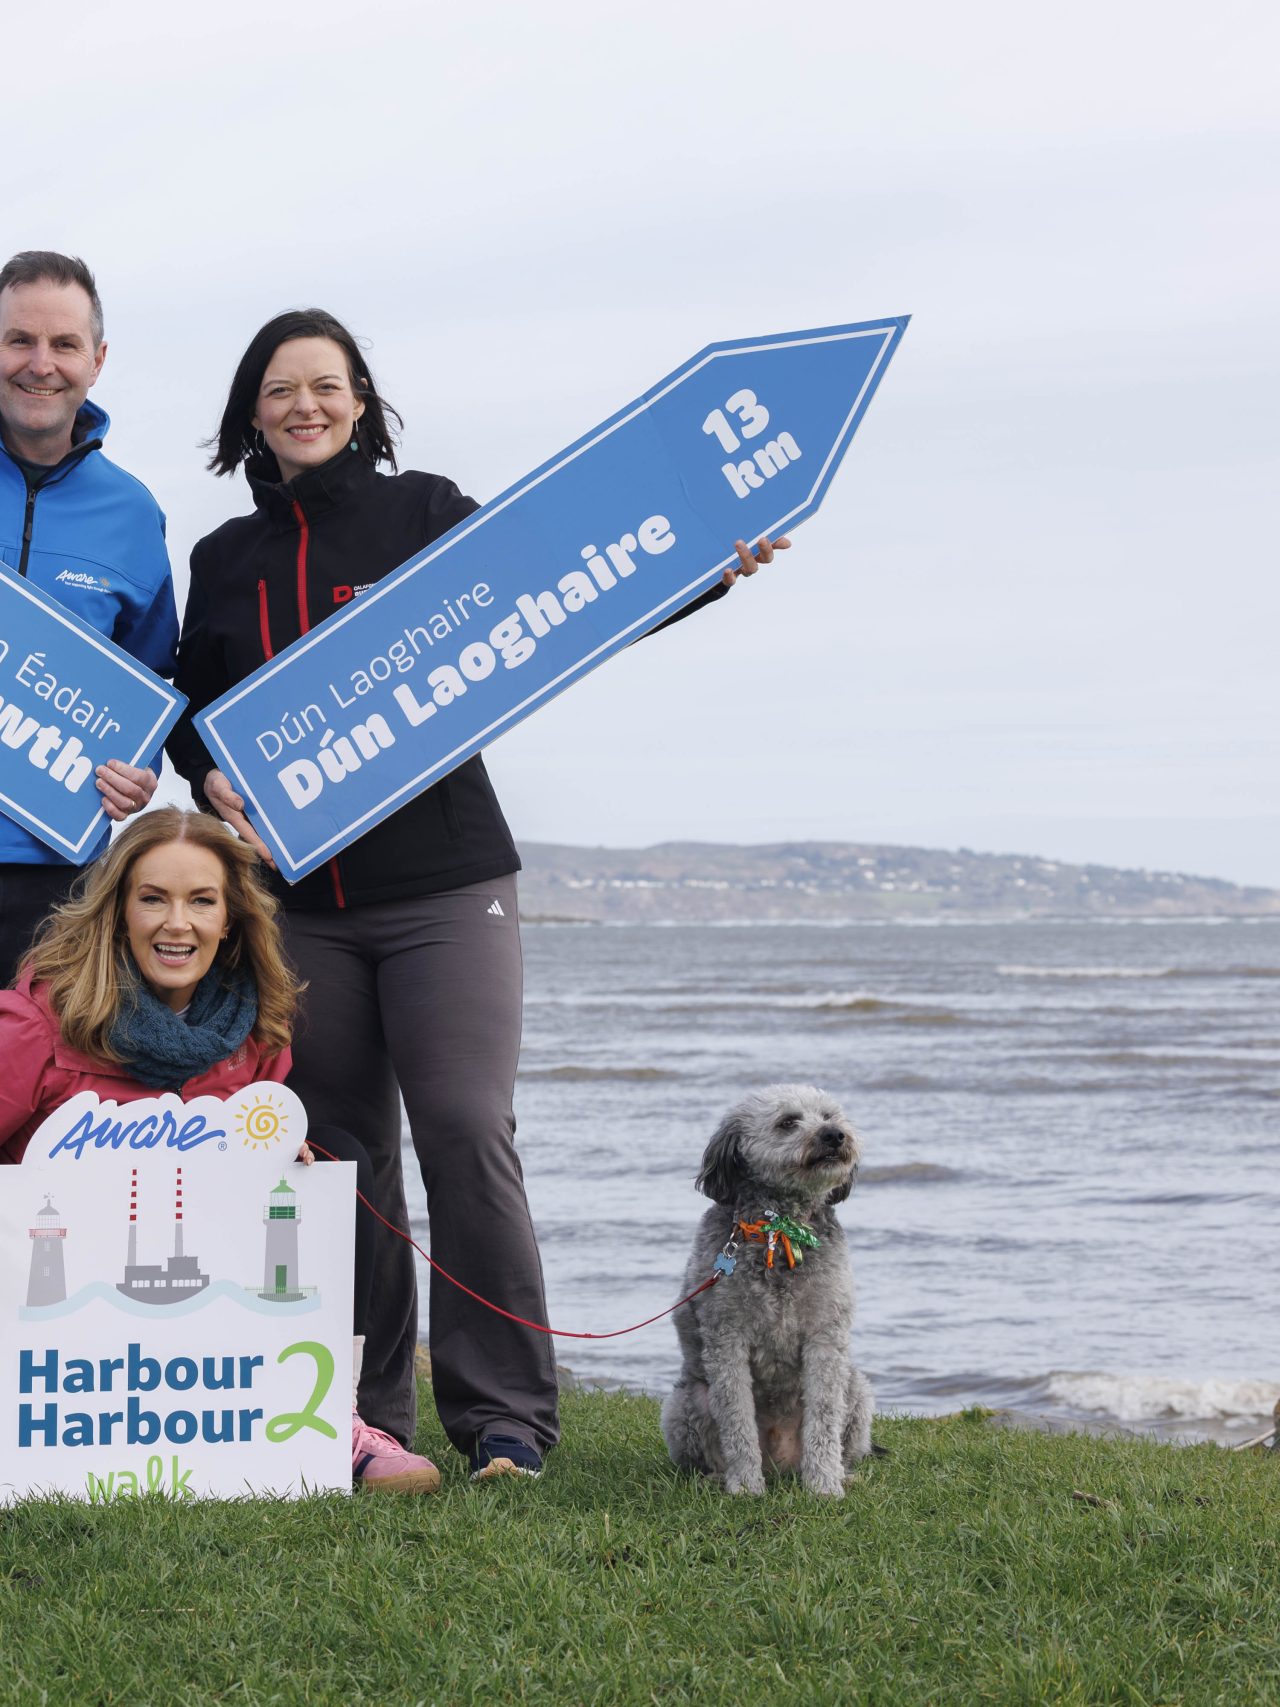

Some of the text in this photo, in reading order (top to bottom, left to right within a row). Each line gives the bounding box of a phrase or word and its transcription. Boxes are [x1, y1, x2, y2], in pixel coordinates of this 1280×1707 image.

[703, 389, 769, 453] 13
[722, 432, 801, 498] km
[55, 569, 98, 585] Aware
[256, 583, 495, 761] Dún Laoghaire
[278, 515, 675, 809] Dún Laoghaire
[15, 652, 121, 740] Éadair
[49, 1110, 226, 1160] Aware
[20, 1343, 264, 1393] Harbour
[265, 1341, 338, 1443] 2
[19, 1397, 263, 1447] Harbour
[87, 1455, 193, 1503] walk
